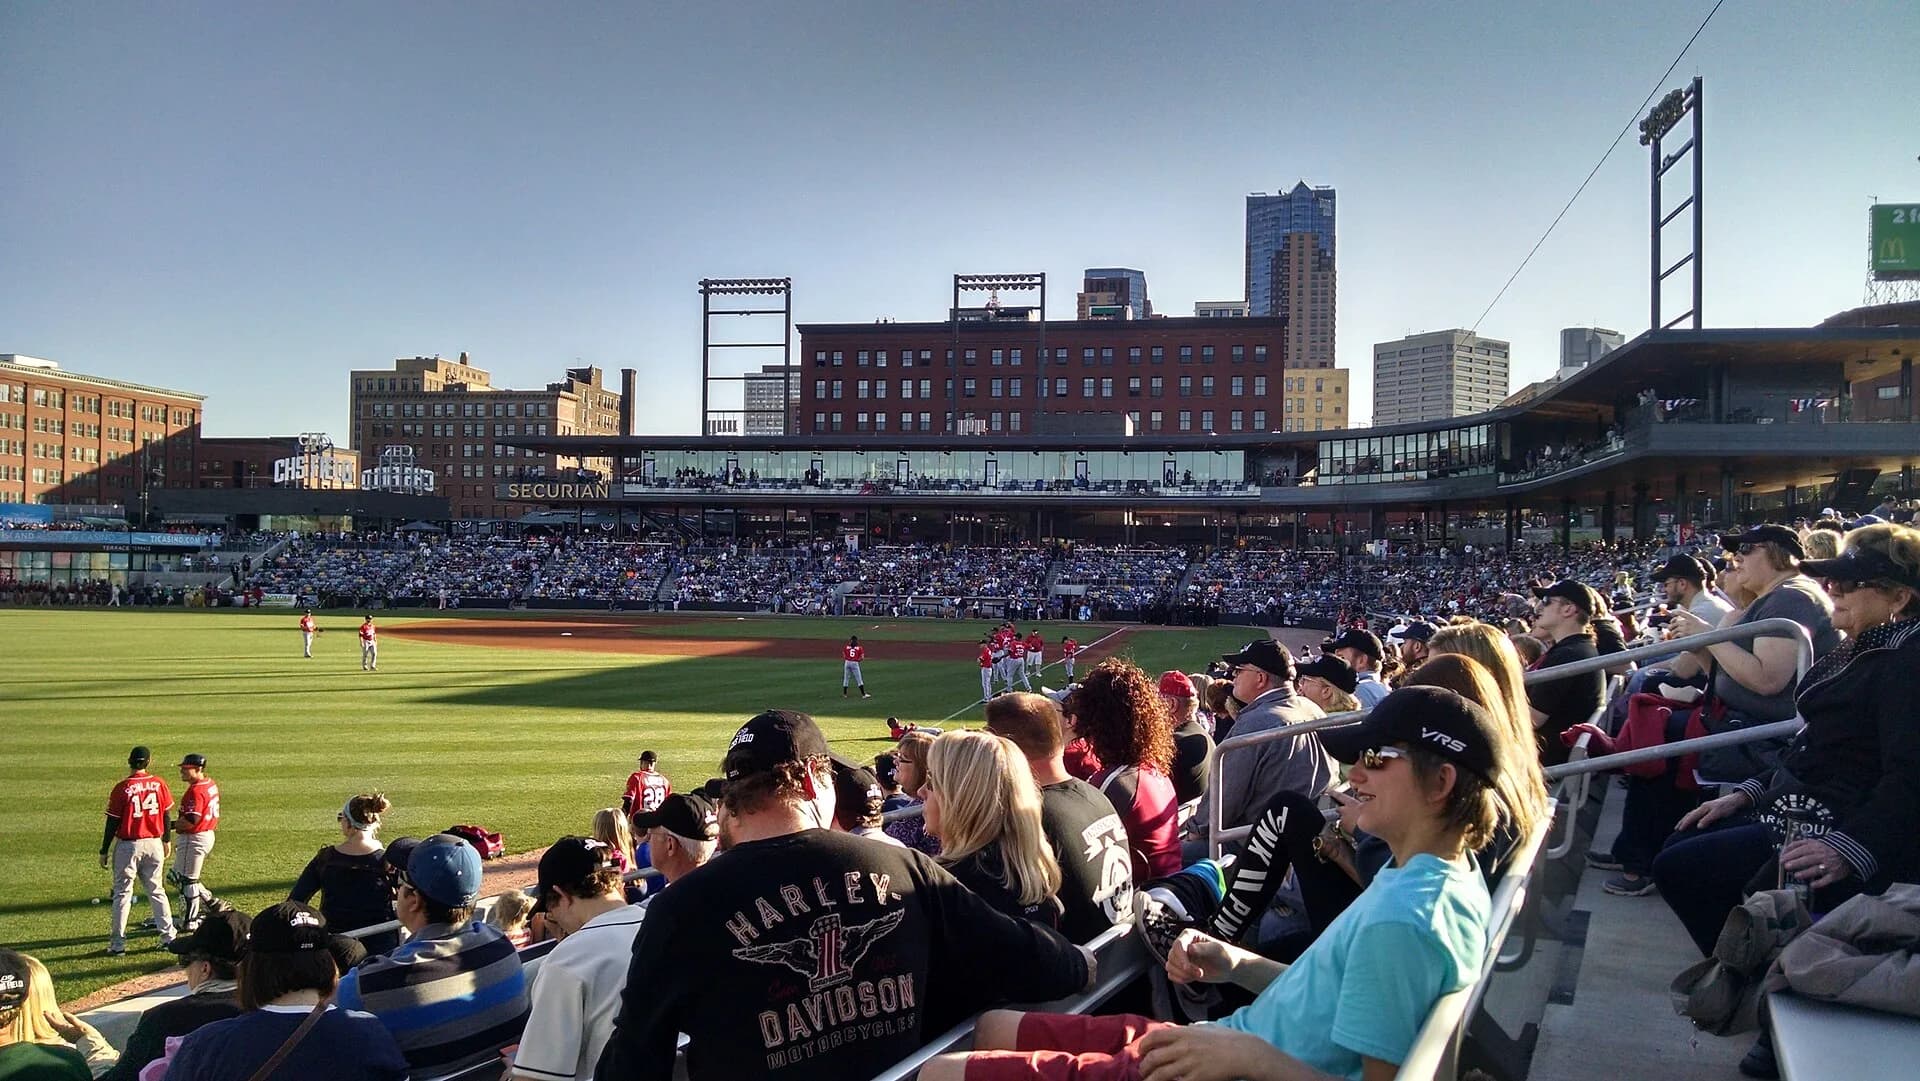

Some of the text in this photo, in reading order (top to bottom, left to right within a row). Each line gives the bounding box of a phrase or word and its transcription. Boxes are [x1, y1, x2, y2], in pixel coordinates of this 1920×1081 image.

[1892, 209, 1905, 223] 2
[274, 456, 304, 483] CHS
[508, 483, 609, 498] SECURIAN
[150, 535, 200, 544] TICASINO.COM
[1422, 727, 1467, 752] VRS
[132, 792, 160, 819] 14
[643, 787, 665, 809] 28
[1214, 806, 1289, 943] PINK PIN
[758, 973, 915, 1049] DAVIDSON
[766, 1013, 916, 1070] MOTORCYCLES
